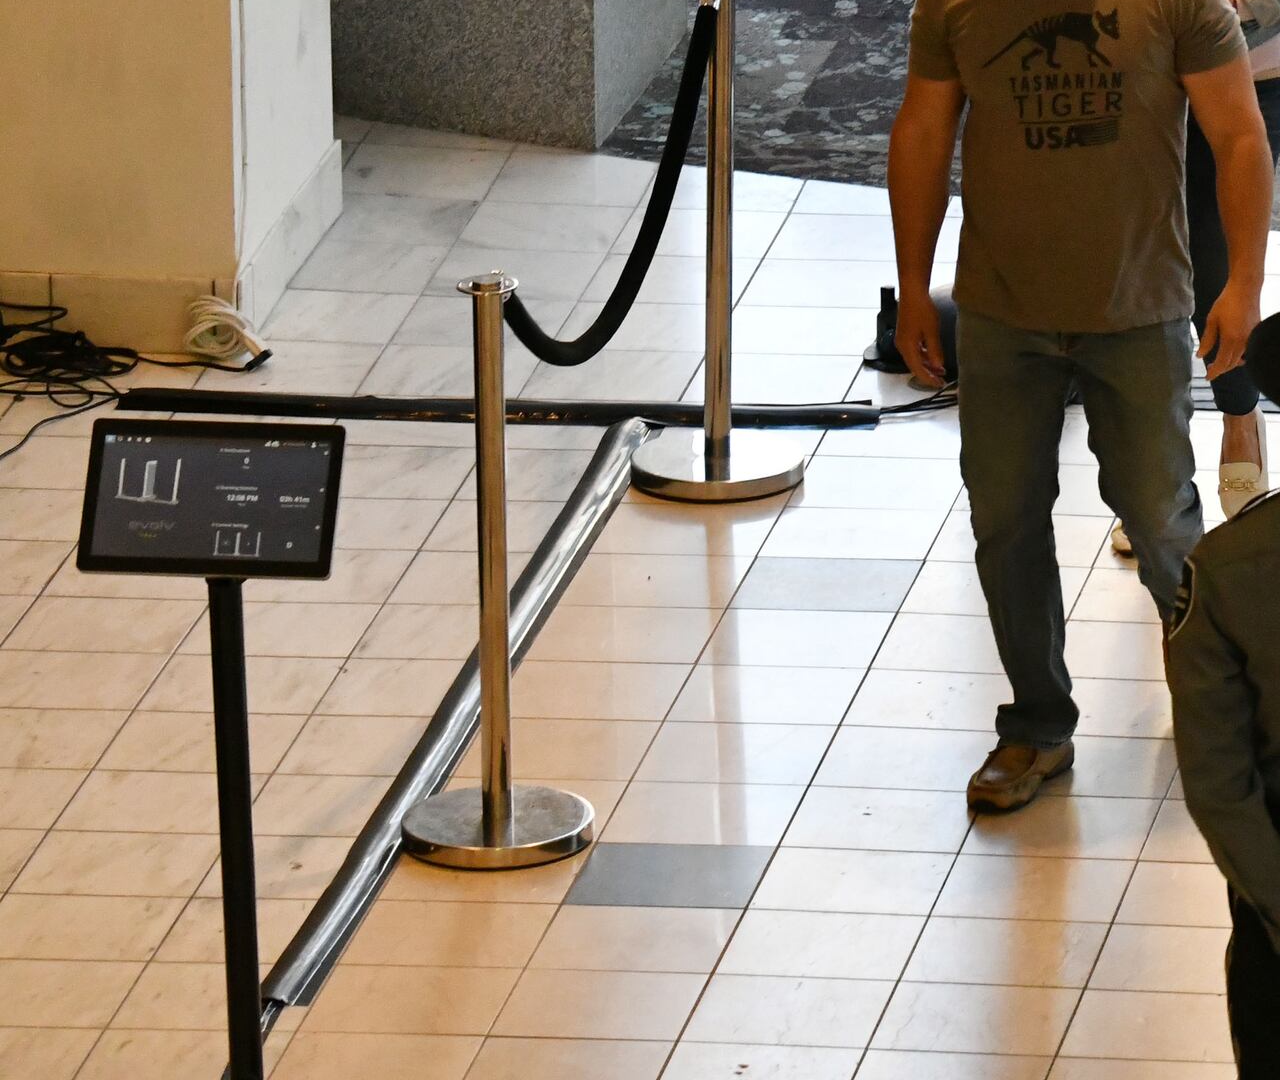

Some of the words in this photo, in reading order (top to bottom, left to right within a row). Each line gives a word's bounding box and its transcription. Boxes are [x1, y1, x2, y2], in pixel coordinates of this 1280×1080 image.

[1009, 71, 1123, 93] TASMANIAN
[1013, 91, 1123, 118] TIGER
[1024, 124, 1085, 150] USA
